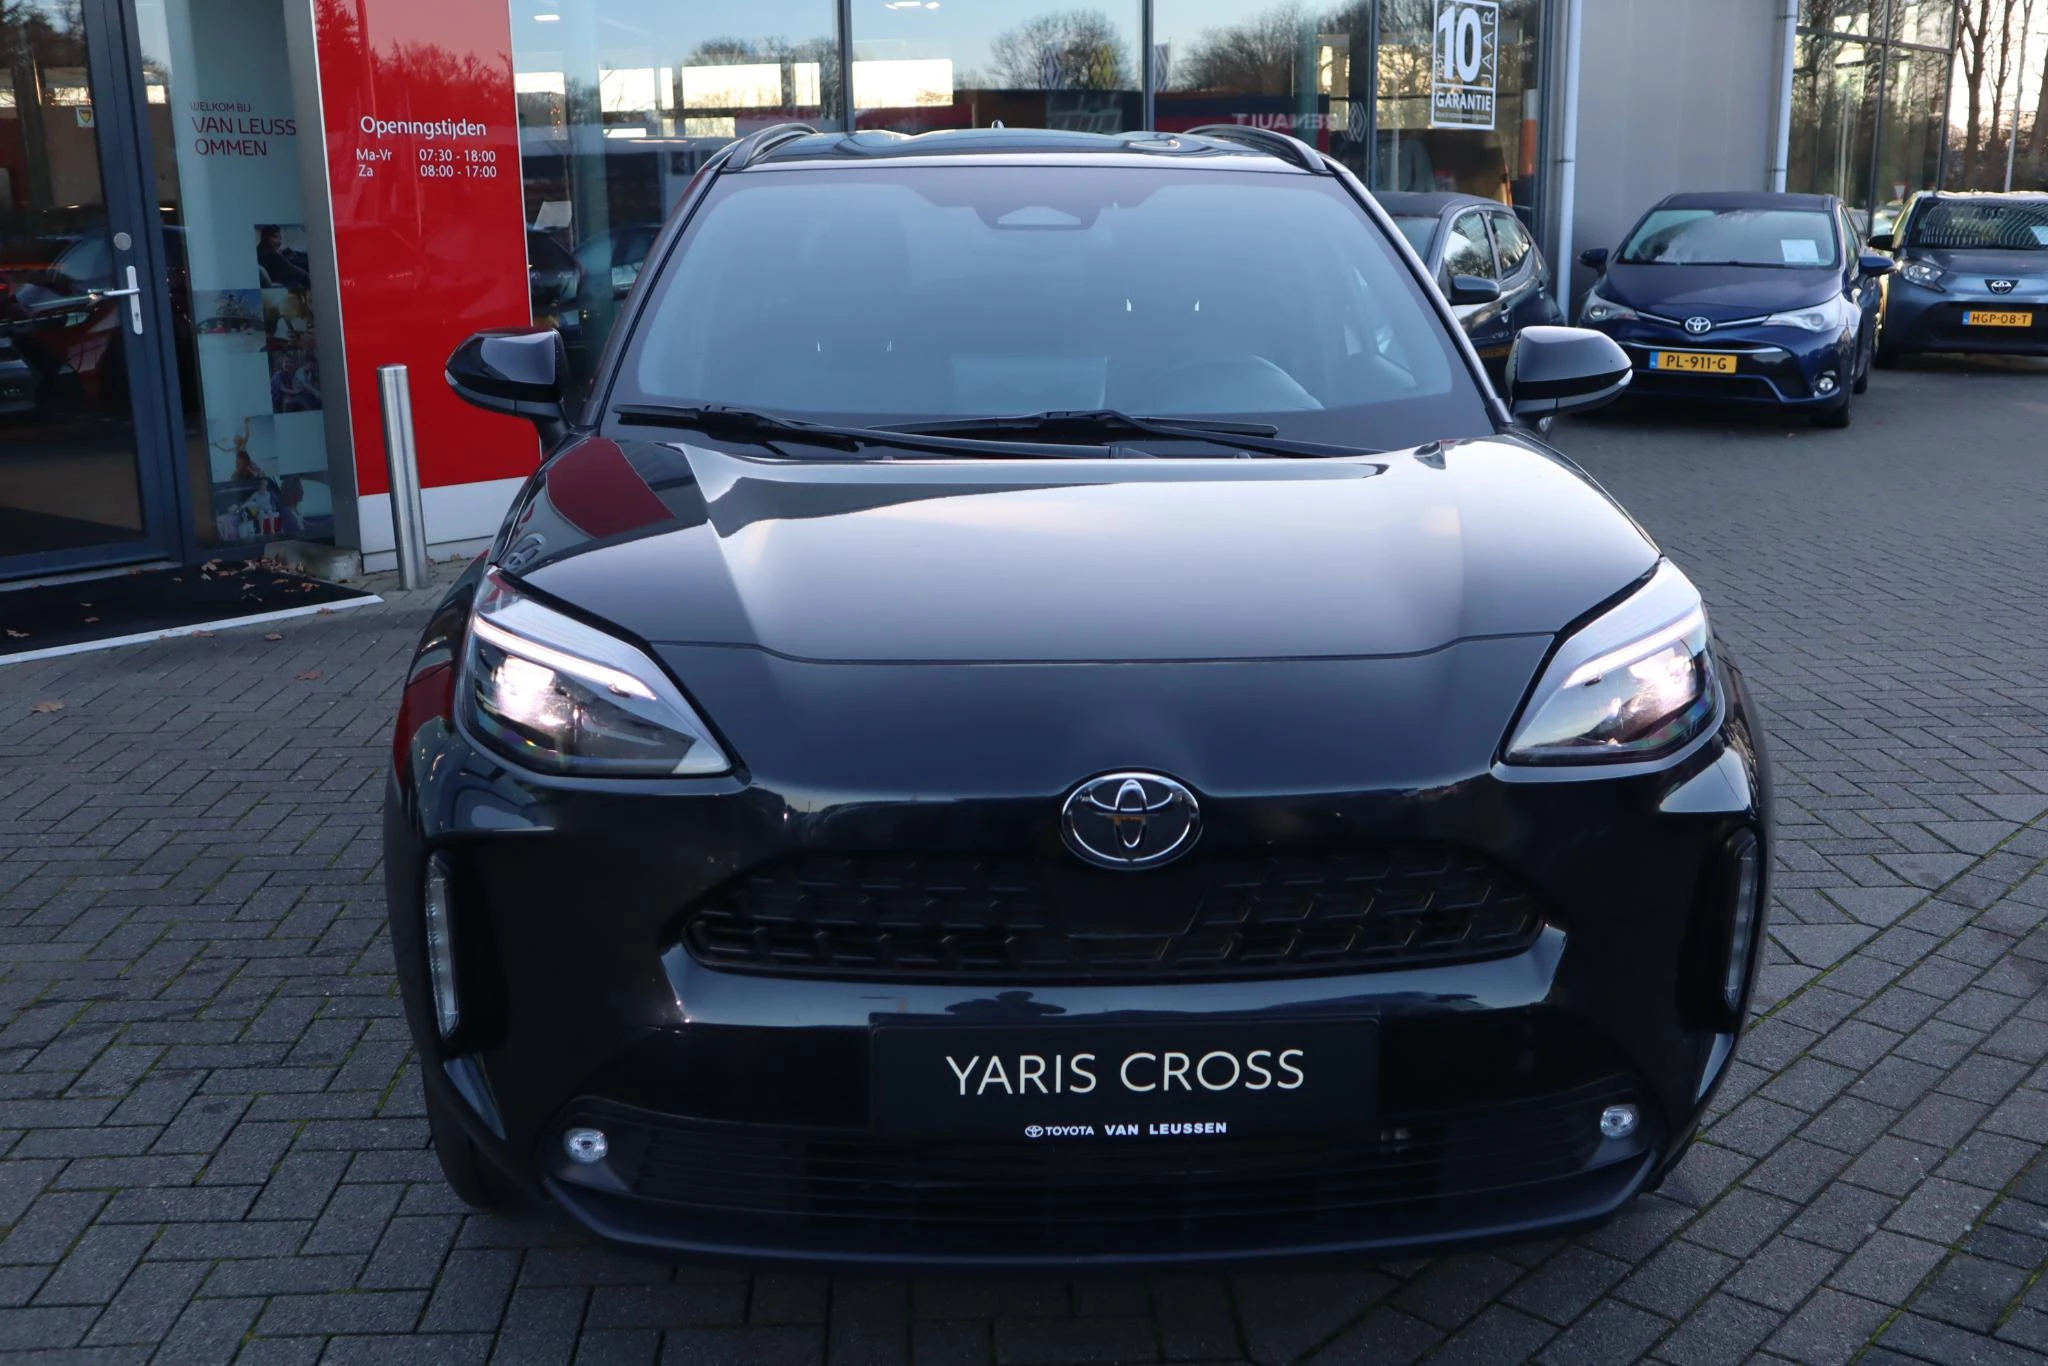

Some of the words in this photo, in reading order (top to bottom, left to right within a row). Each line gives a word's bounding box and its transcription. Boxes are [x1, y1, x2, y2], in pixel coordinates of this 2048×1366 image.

[1438, 5, 1481, 82] 10
[1481, 11, 1494, 83] JAAR
[191, 101, 235, 112] WELKOM
[1435, 92, 1492, 111] GARANTIE
[192, 116, 233, 134] VAN
[360, 116, 487, 140] Openingstijden
[195, 138, 267, 156] OMMEN
[356, 148, 392, 161] Ma-Vr
[419, 149, 453, 161] 07:30
[464, 150, 496, 162] 18:00
[358, 164, 374, 177] Za
[420, 165, 454, 177] 08:00
[465, 166, 497, 178] 17:00
[1972, 313, 2029, 325] HGP-08-T
[1666, 354, 1728, 370] PL-911-G
[945, 1053, 1097, 1096] YARIS
[1119, 1049, 1305, 1092] CROSS
[1045, 1126, 1095, 1136] TOYOTA
[1104, 1124, 1139, 1136] VAN
[1149, 1122, 1228, 1135] LEUSSEN
